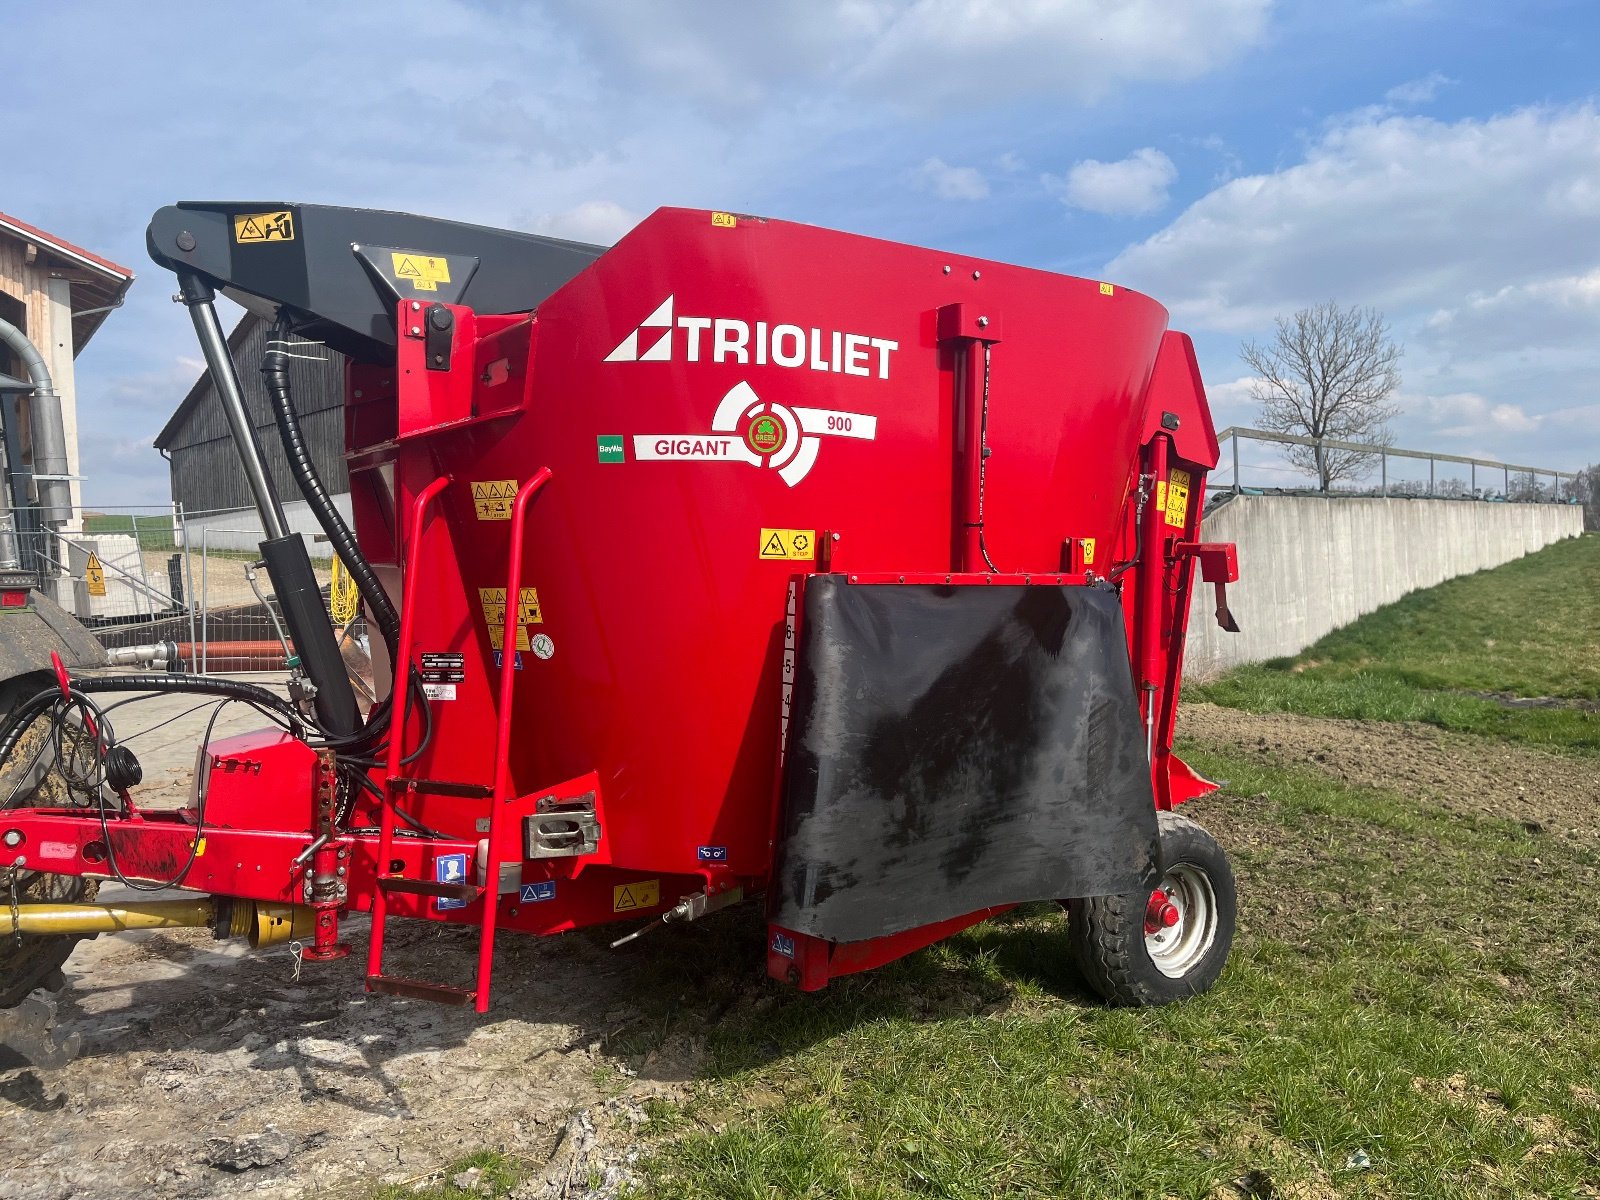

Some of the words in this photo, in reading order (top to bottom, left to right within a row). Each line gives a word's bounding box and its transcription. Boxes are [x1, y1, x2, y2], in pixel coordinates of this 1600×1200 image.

[677, 316, 898, 380] TRIOLIET
[827, 416, 852, 431] 900
[599, 445, 623, 454] BayWa
[654, 440, 731, 456] GIGANT
[786, 624, 792, 640] 6
[785, 658, 791, 674] 5
[784, 693, 791, 708] 4
